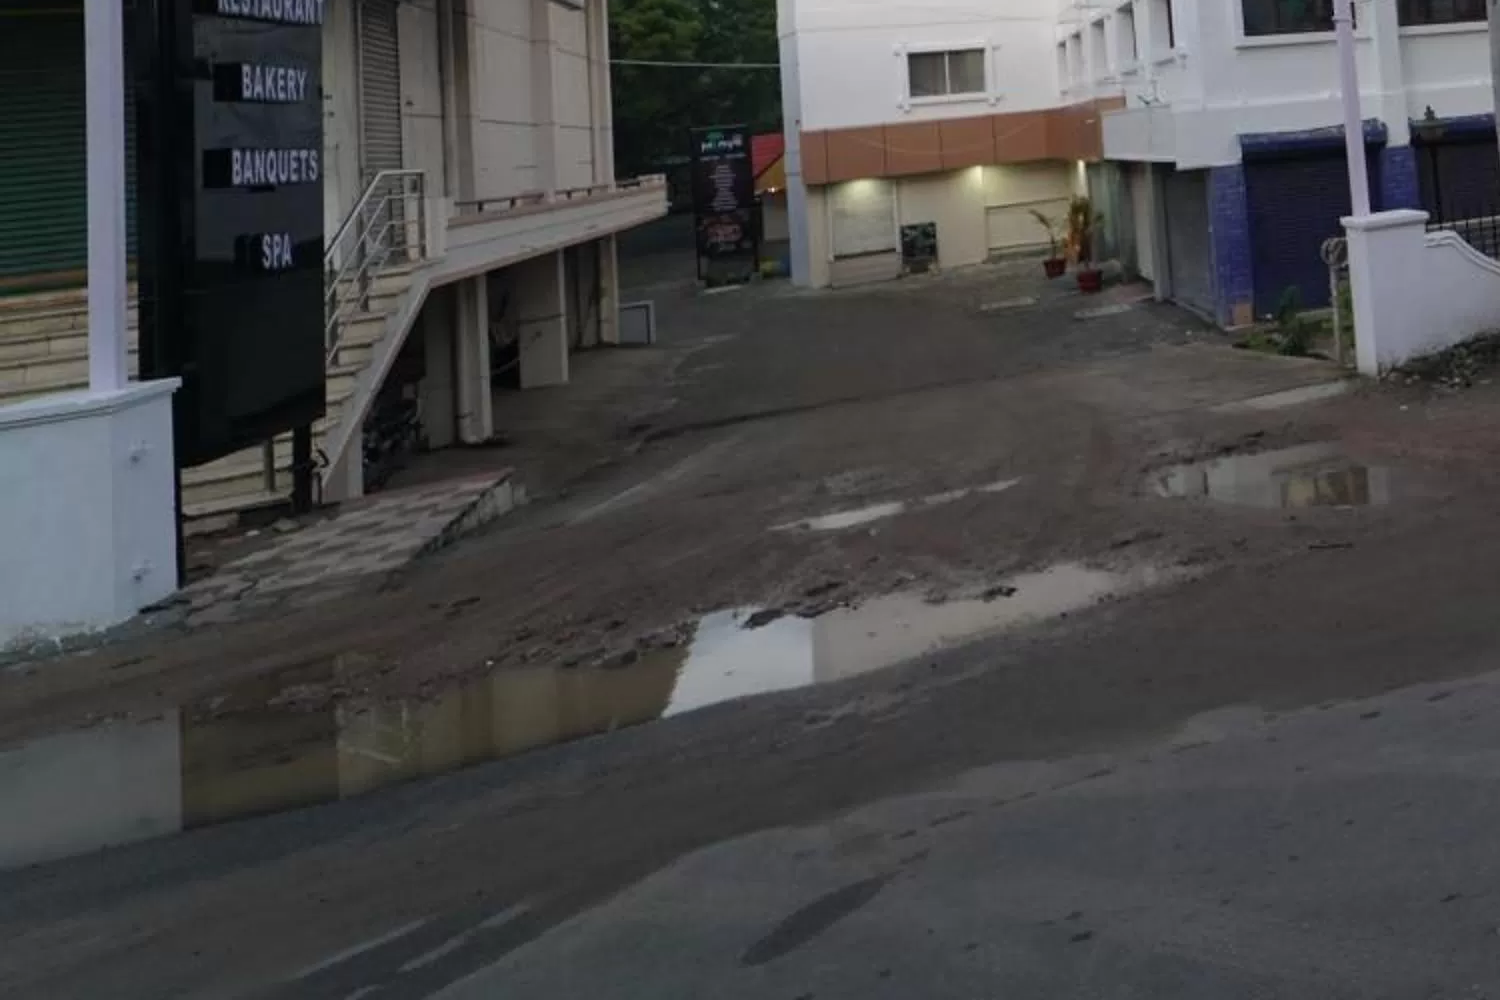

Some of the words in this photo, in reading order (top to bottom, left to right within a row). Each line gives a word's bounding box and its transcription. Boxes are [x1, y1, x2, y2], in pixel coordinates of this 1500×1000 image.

[242, 63, 307, 100] BAKERY
[232, 149, 319, 185] BANQUETS
[262, 233, 293, 269] SPA
